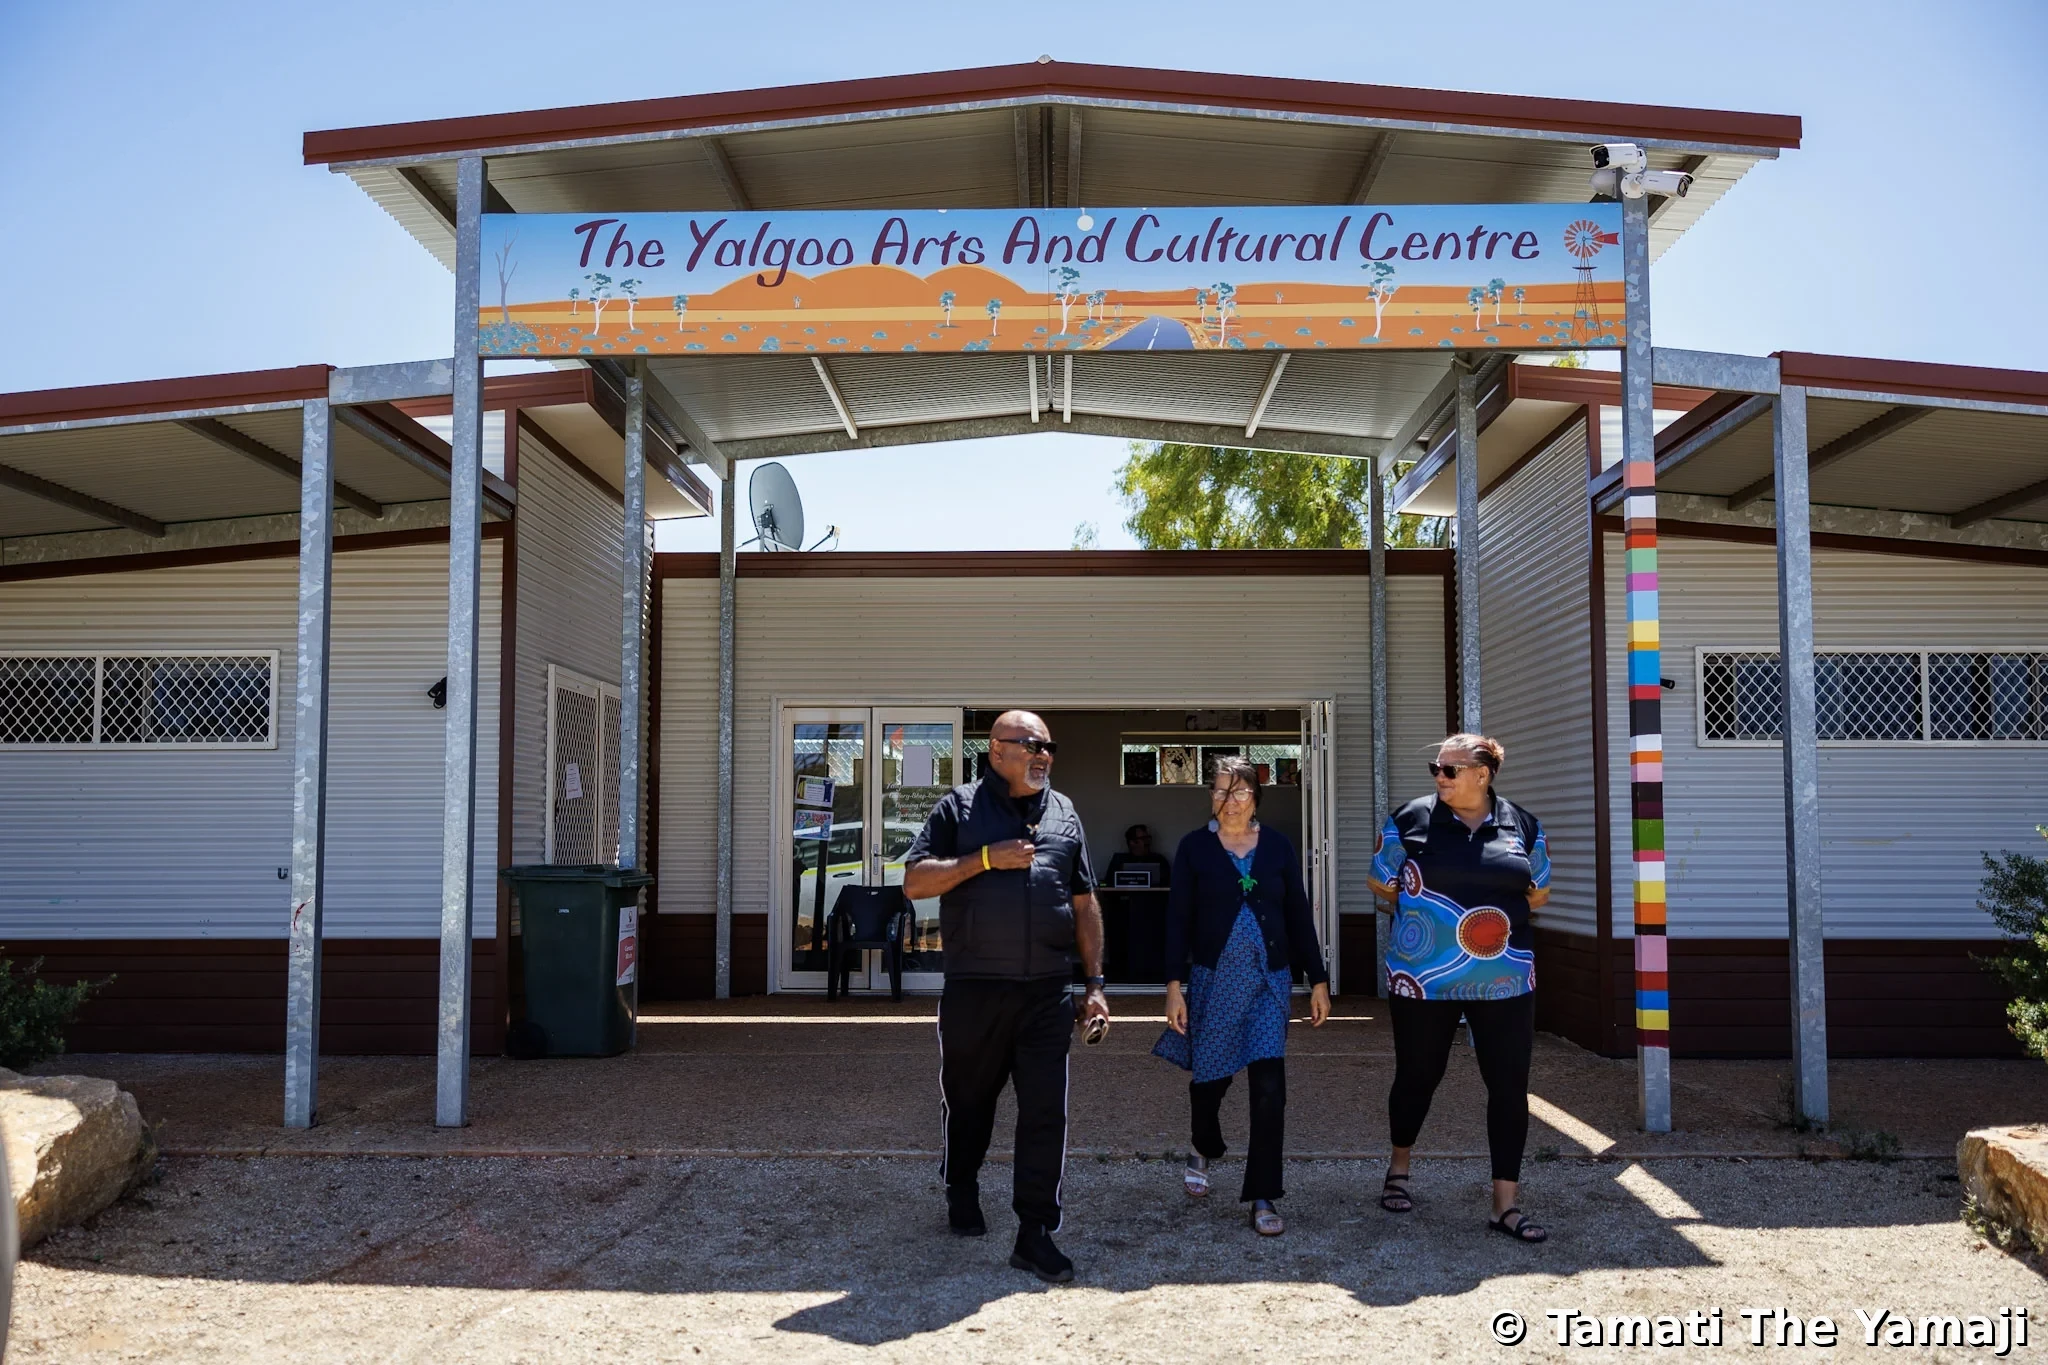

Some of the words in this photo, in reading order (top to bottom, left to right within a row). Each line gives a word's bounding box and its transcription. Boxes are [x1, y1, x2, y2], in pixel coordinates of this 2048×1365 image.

[575, 218, 665, 268] The
[687, 218, 854, 288] Yalgoo
[872, 217, 985, 266] Arts
[1003, 215, 1116, 265] And
[1126, 214, 1352, 263] Cultural
[1360, 212, 1540, 261] Centre
